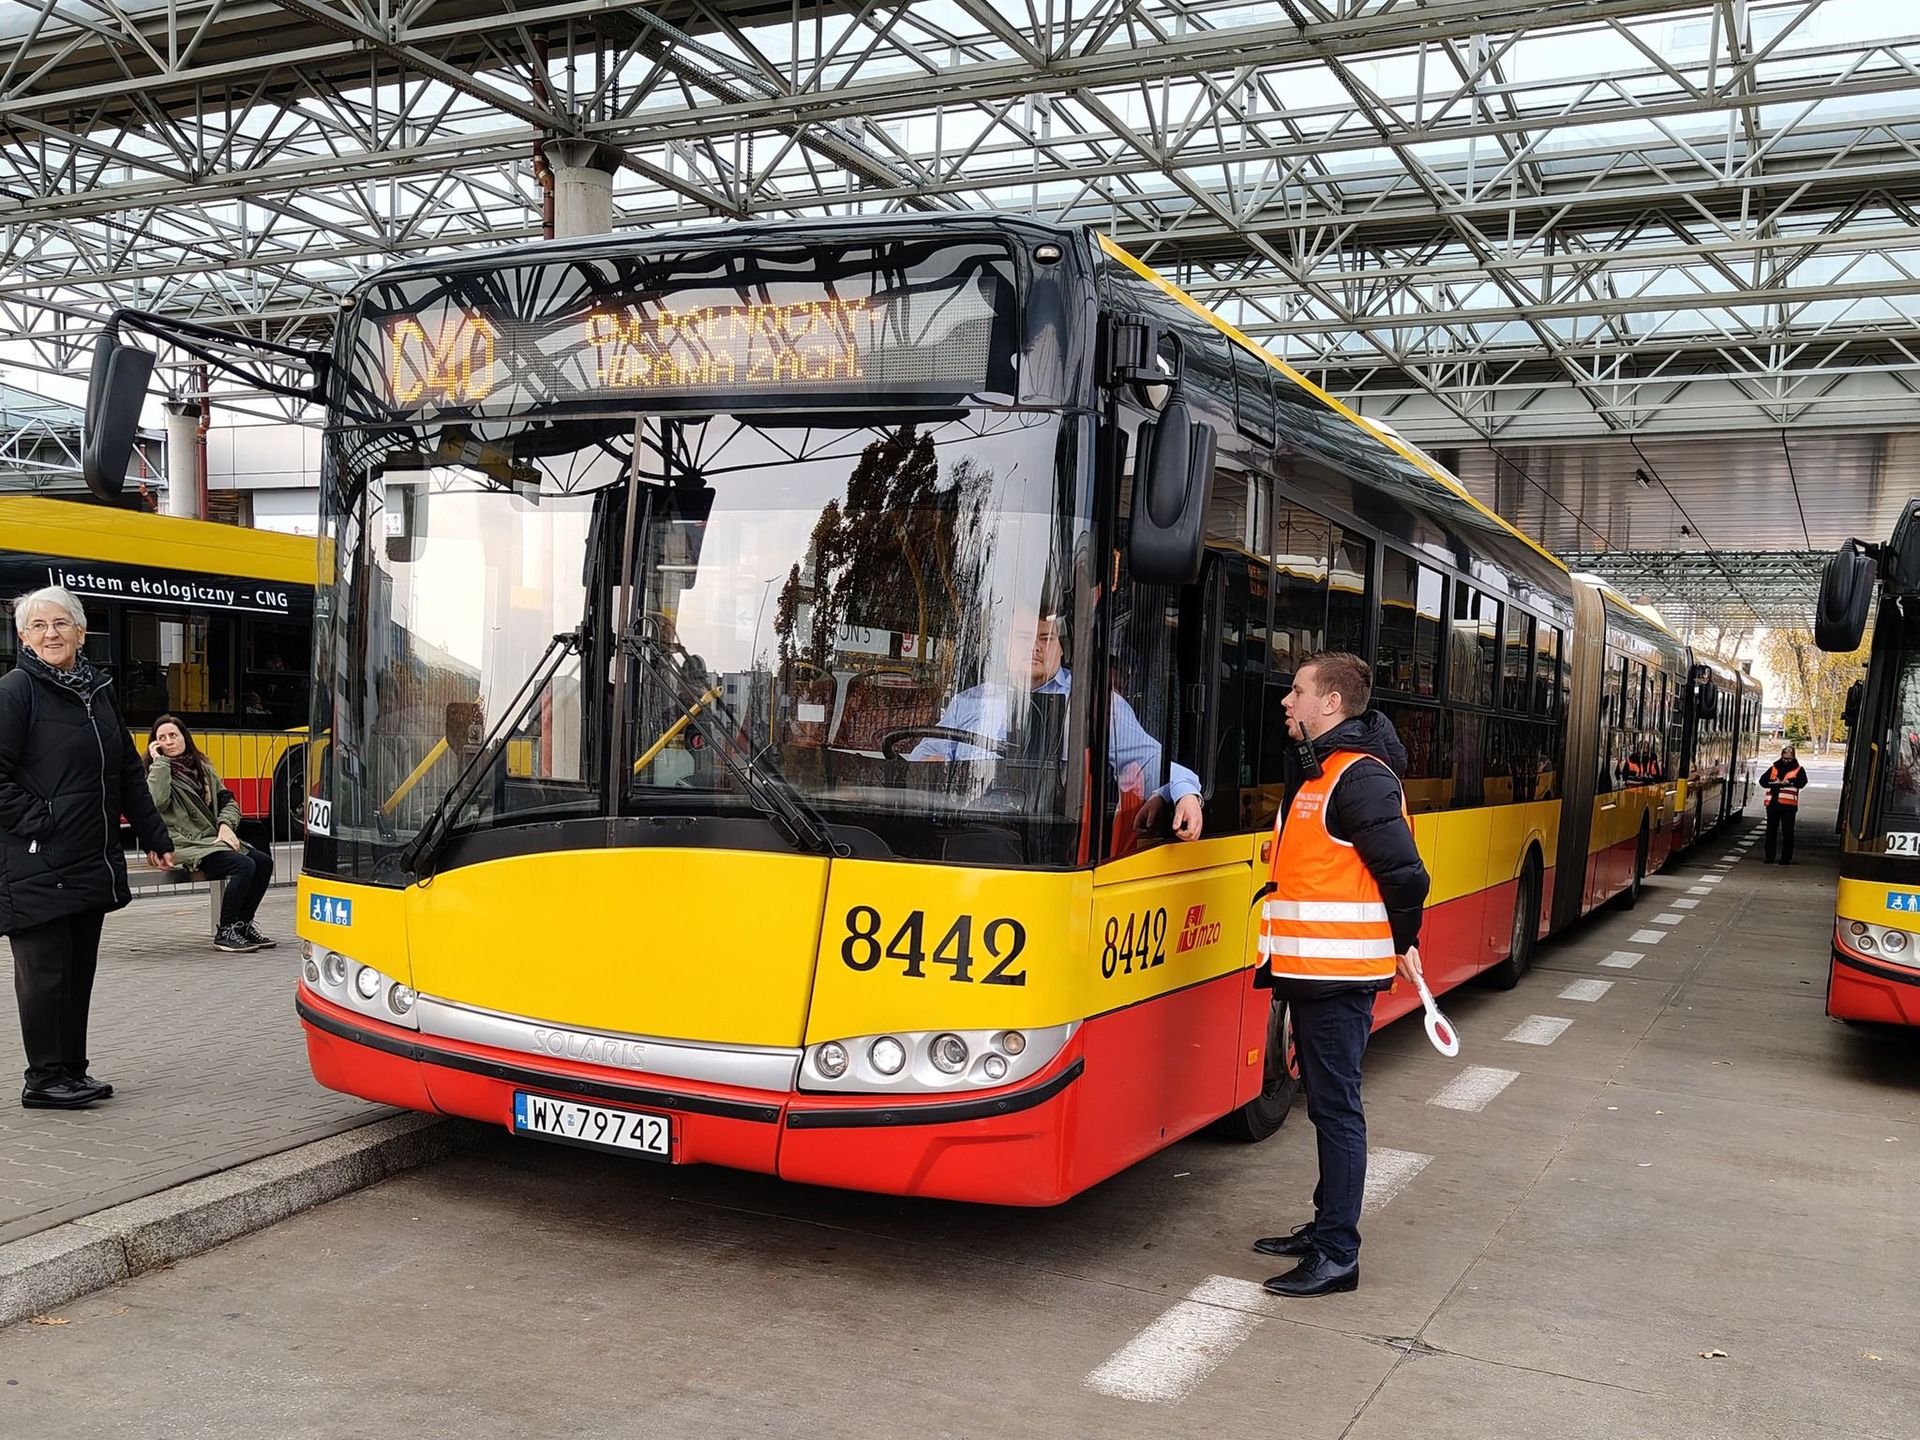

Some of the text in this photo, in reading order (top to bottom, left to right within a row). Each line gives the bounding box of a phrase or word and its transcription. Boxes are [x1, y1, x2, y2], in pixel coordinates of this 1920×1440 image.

[393, 317, 493, 402] C40
[130, 577, 236, 606] ekologiczny
[255, 590, 289, 608] CNG
[308, 800, 330, 829] 020
[1887, 834, 1918, 851] 021
[840, 905, 1028, 987] 8442
[1101, 906, 1168, 980] 8442
[532, 1029, 646, 1070] SOLARIS
[517, 1114, 527, 1124] PL
[576, 1107, 663, 1151] 79742
